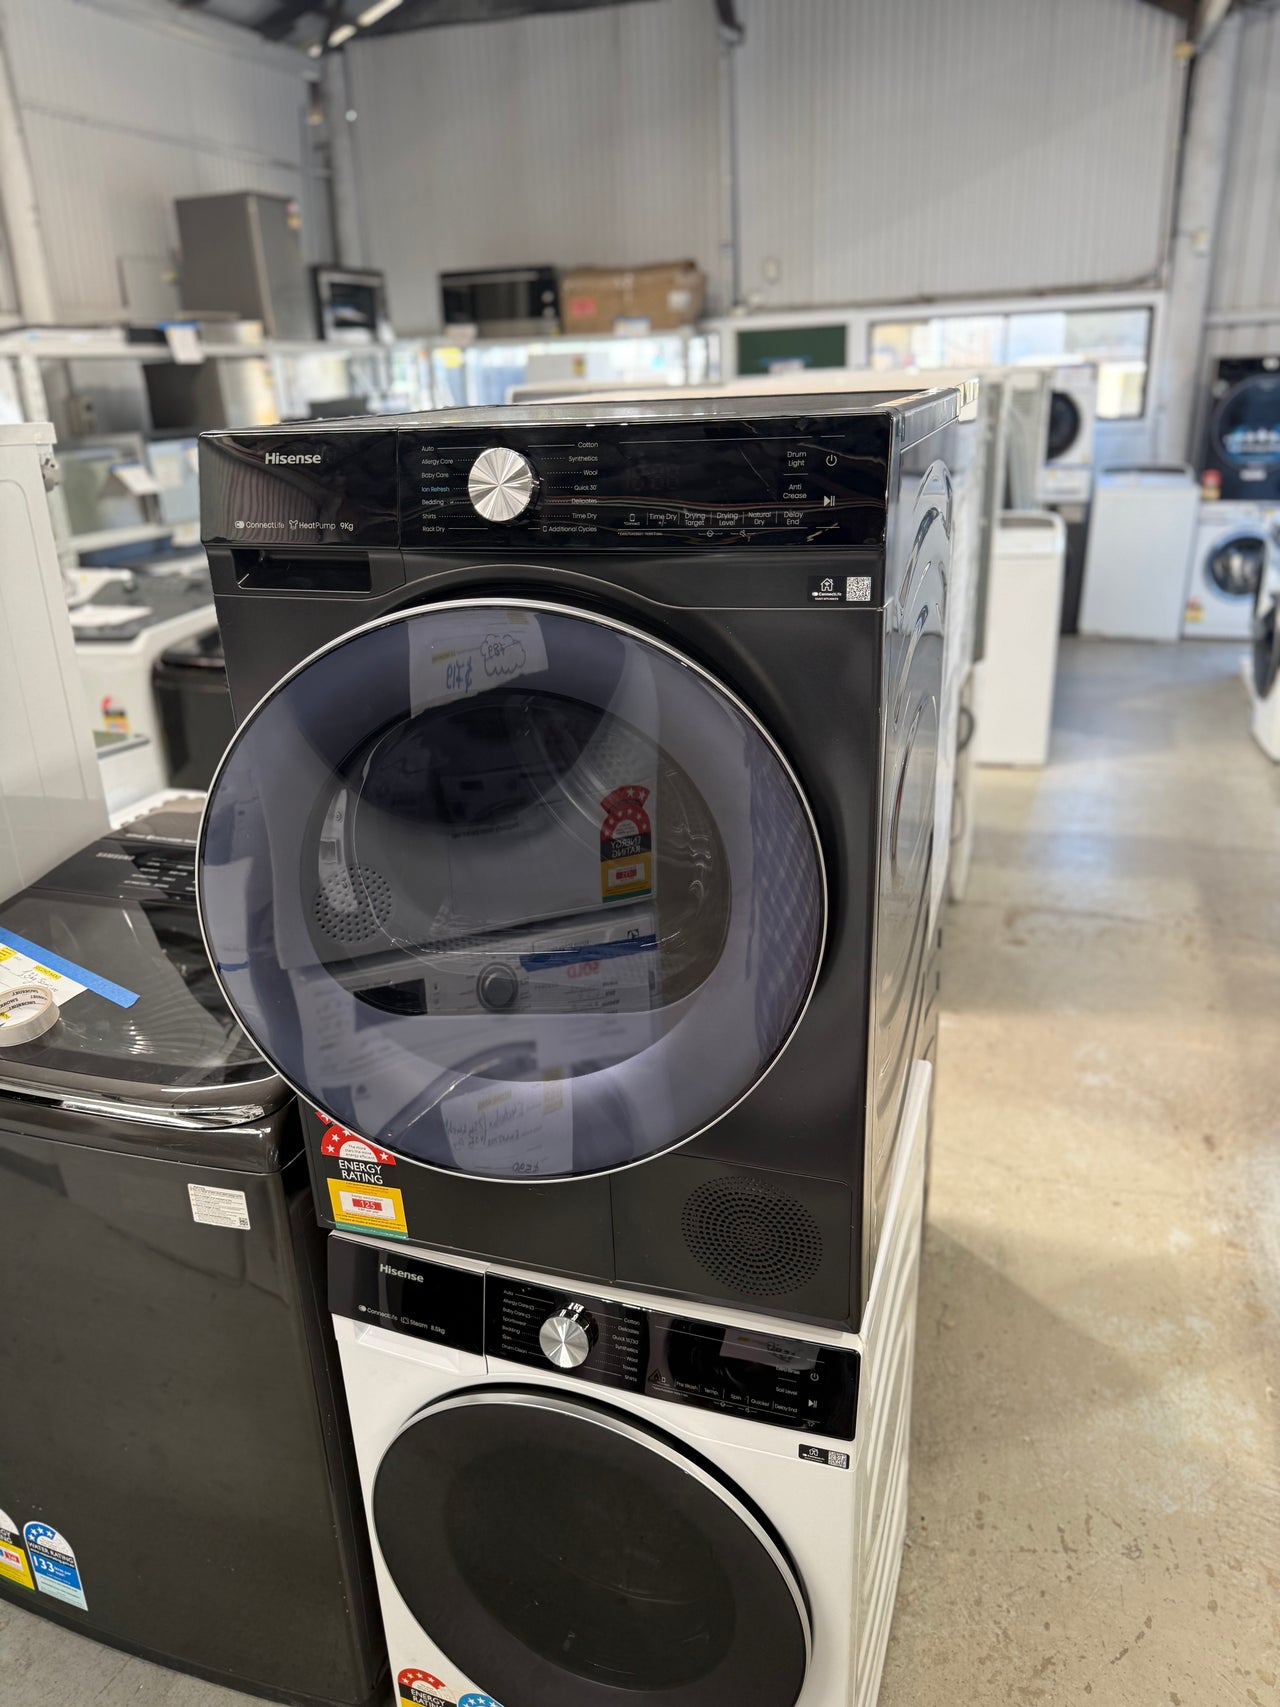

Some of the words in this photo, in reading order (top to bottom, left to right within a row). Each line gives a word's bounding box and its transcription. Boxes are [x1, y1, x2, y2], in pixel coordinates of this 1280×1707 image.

[265, 452, 322, 465] Hisense
[568, 455, 599, 463] Synthetics
[587, 512, 597, 520] Dry
[666, 513, 677, 521] Dry
[716, 512, 739, 520] Drying
[246, 520, 285, 529] ConnectLife
[299, 521, 336, 530] HeatPump
[340, 522, 354, 531] 9Kg
[685, 520, 705, 528] Target
[754, 518, 765, 526] Dry
[578, 525, 597, 533] Cycles
[338, 1159, 382, 1174] ENERGY
[341, 1170, 384, 1185] RATING
[359, 1200, 376, 1210] 125
[379, 1263, 424, 1283] Hisense
[503, 1298, 518, 1308] Allergy
[517, 1301, 530, 1309] Care
[502, 1307, 514, 1315] Baby
[513, 1309, 526, 1317] Care
[410, 1319, 429, 1329] Steam
[502, 1316, 527, 1326] Sportswear
[623, 1317, 641, 1326] Cotton
[502, 1325, 521, 1334] Bedding
[617, 1325, 640, 1335] Delicates
[611, 1334, 626, 1343] Quick
[501, 1343, 515, 1351] Drum
[515, 1346, 528, 1354] Clean
[614, 1344, 639, 1354] Synthetics
[626, 1355, 639, 1363] Wool
[622, 1363, 638, 1372] Towels
[624, 1374, 638, 1382] Shirts
[685, 1382, 698, 1391] Wash
[775, 1386, 785, 1394] Soil
[785, 1388, 798, 1396] Level
[704, 1387, 719, 1396] Temp.
[730, 1393, 742, 1401] Spin
[750, 1398, 770, 1407] Quicker
[774, 1403, 787, 1412] Delay
[29, 1542, 50, 1554] WATER
[50, 1549, 75, 1564] RATING
[33, 1555, 55, 1573] 133
[410, 1688, 446, 1706] ENERGY
